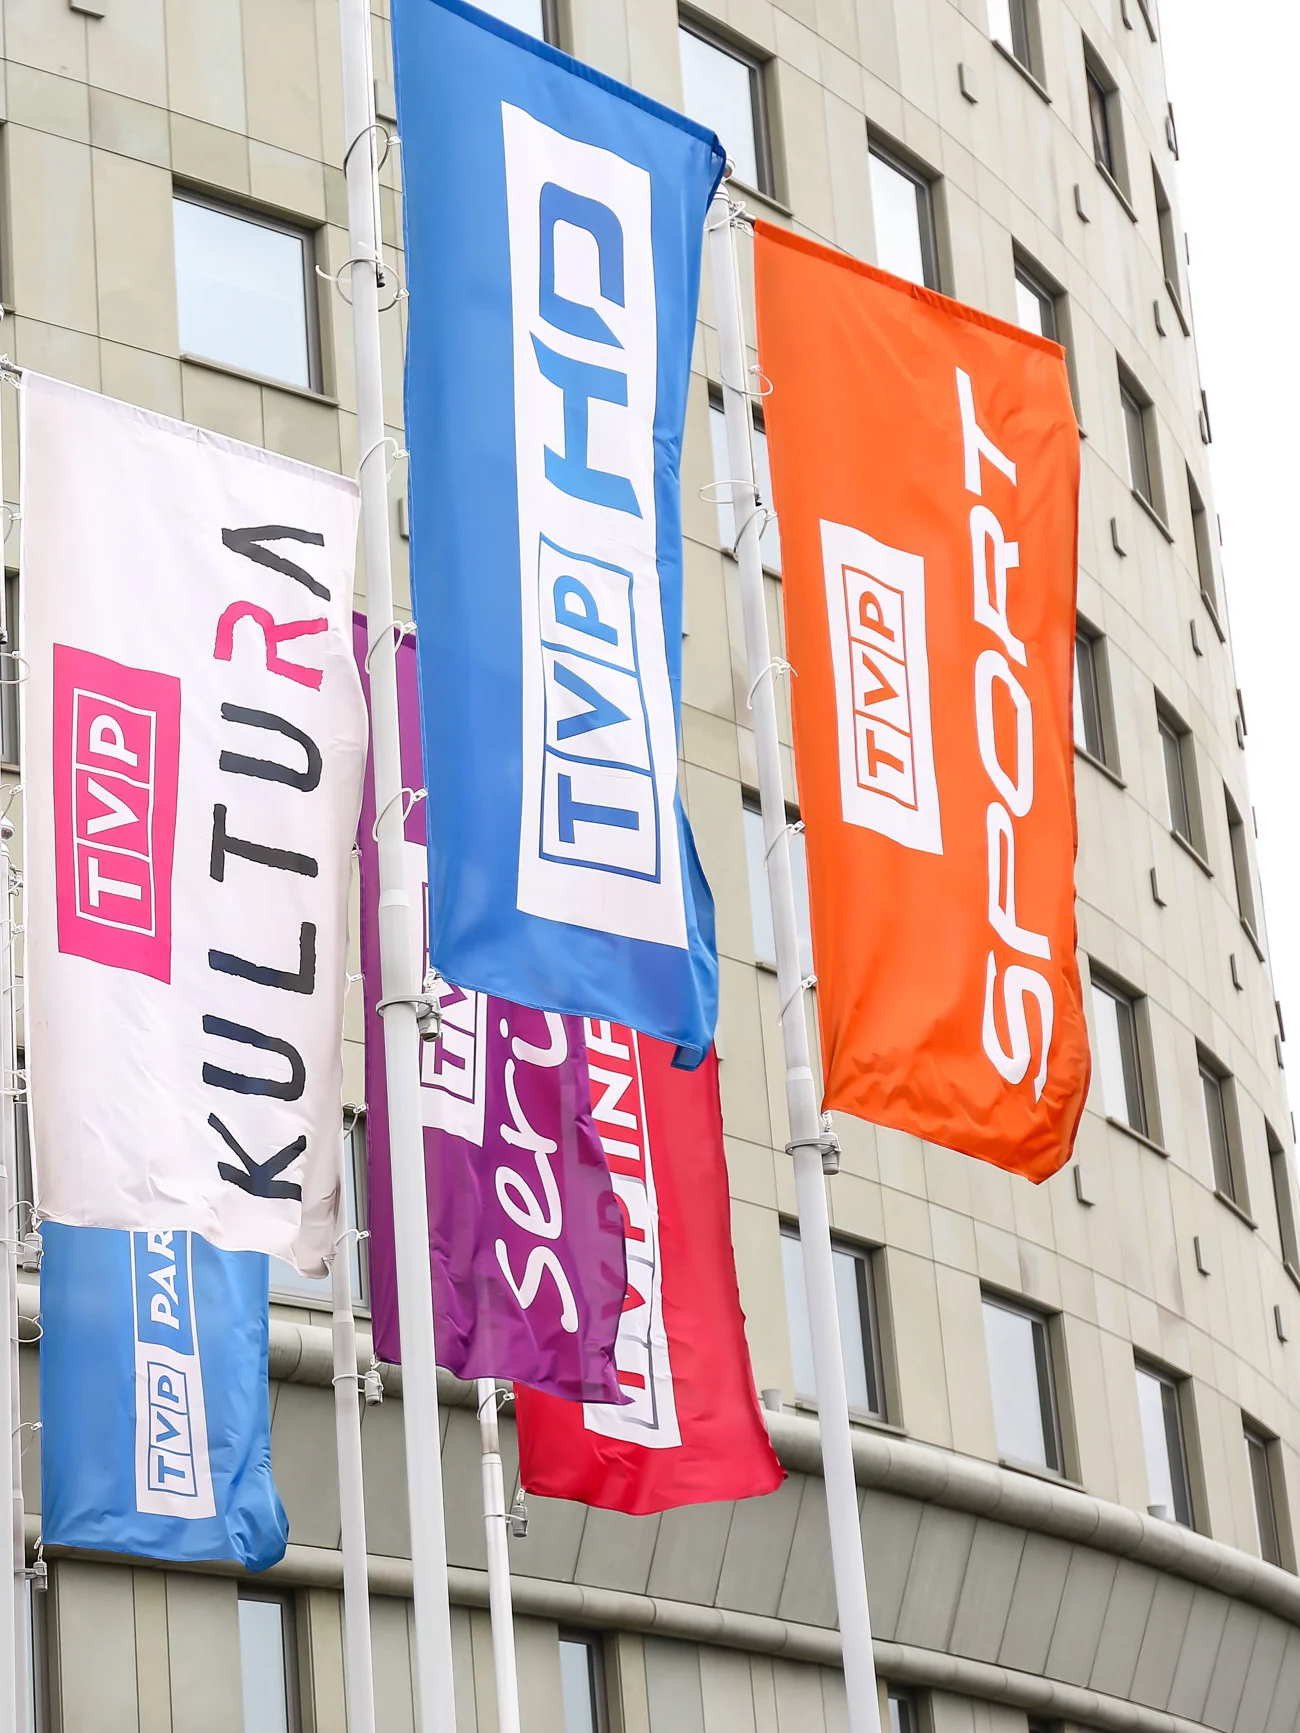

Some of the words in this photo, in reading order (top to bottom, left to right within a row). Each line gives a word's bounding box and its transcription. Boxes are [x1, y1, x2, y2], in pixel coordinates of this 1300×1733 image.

[531, 181, 643, 519] HD
[553, 575, 640, 845] TVP
[858, 590, 906, 779] TVP
[955, 366, 1054, 1104] SPORT
[87, 713, 142, 909] TVP
[200, 524, 332, 1205] KULTURA
[494, 1010, 579, 1334] seri
[583, 1016, 642, 1162] INF
[147, 1231, 181, 1331] PAR
[155, 1374, 188, 1484] TVP
